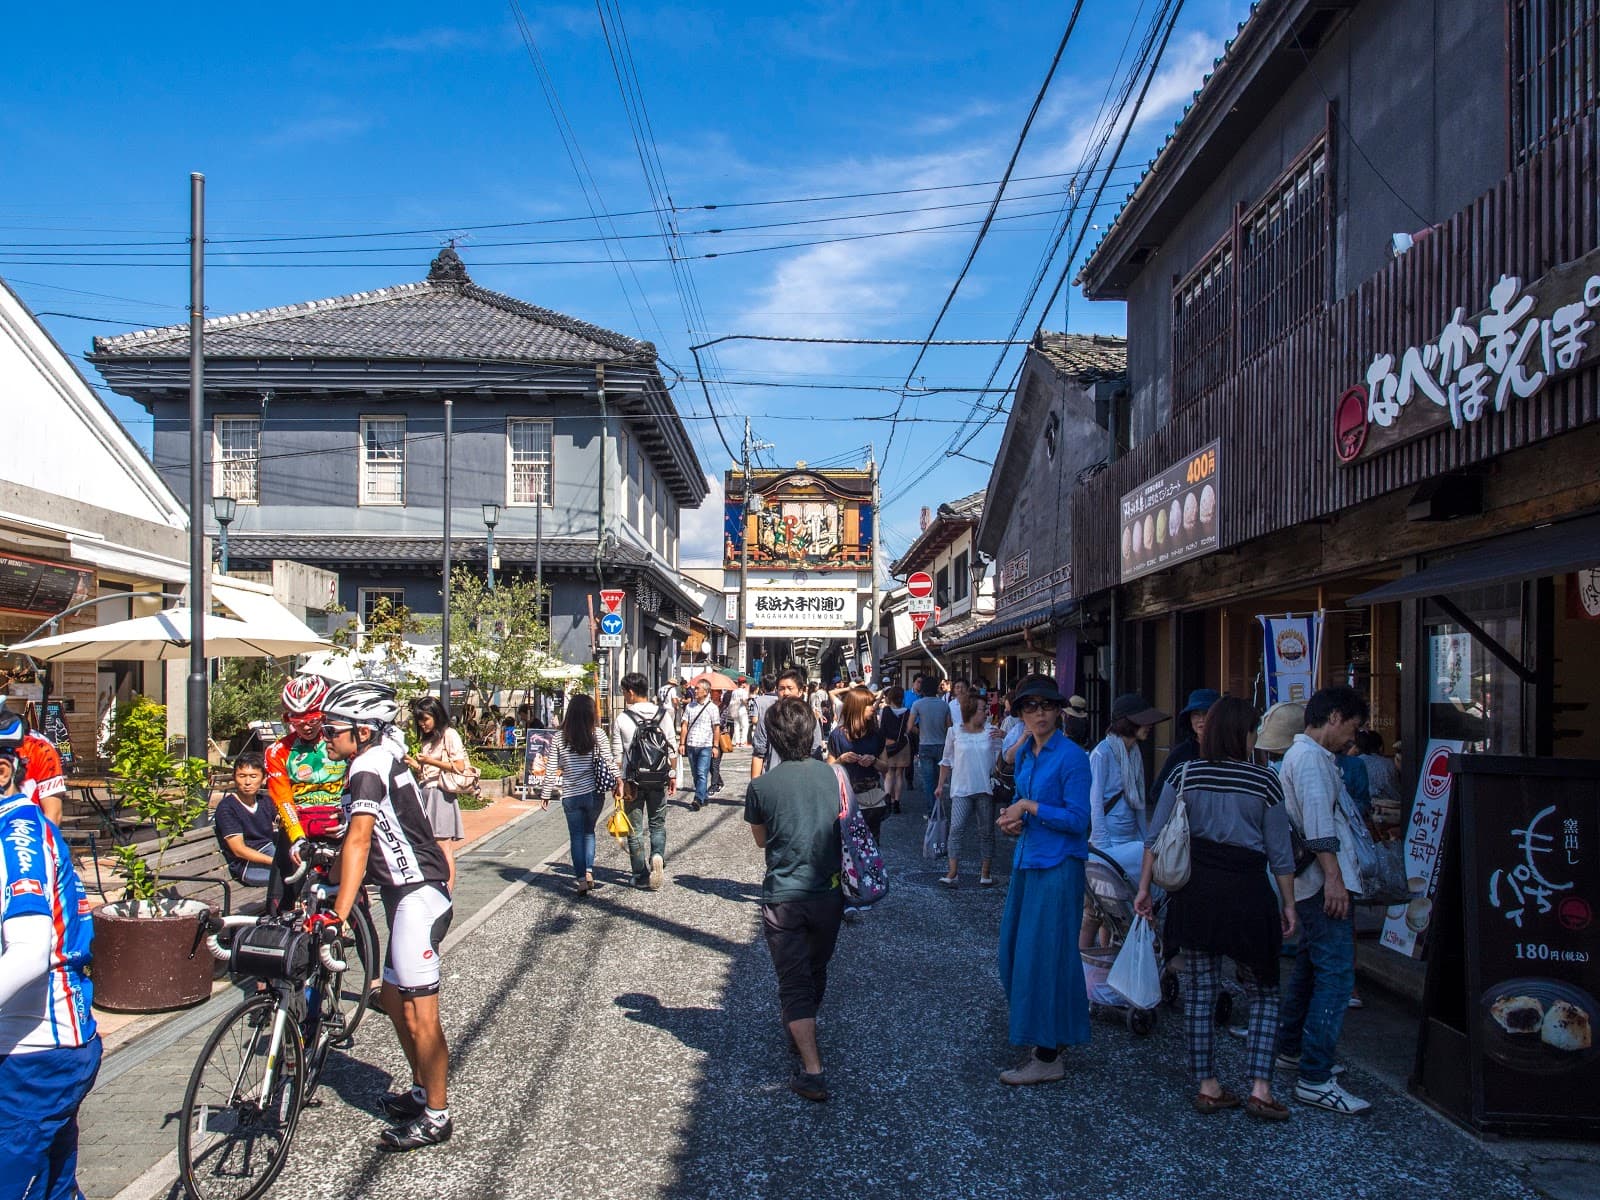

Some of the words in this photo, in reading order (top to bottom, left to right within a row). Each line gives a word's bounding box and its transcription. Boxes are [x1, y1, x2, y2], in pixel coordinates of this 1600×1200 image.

[755, 596, 845, 611] 長浜大手門通り
[1563, 817, 1580, 865] 窯出し
